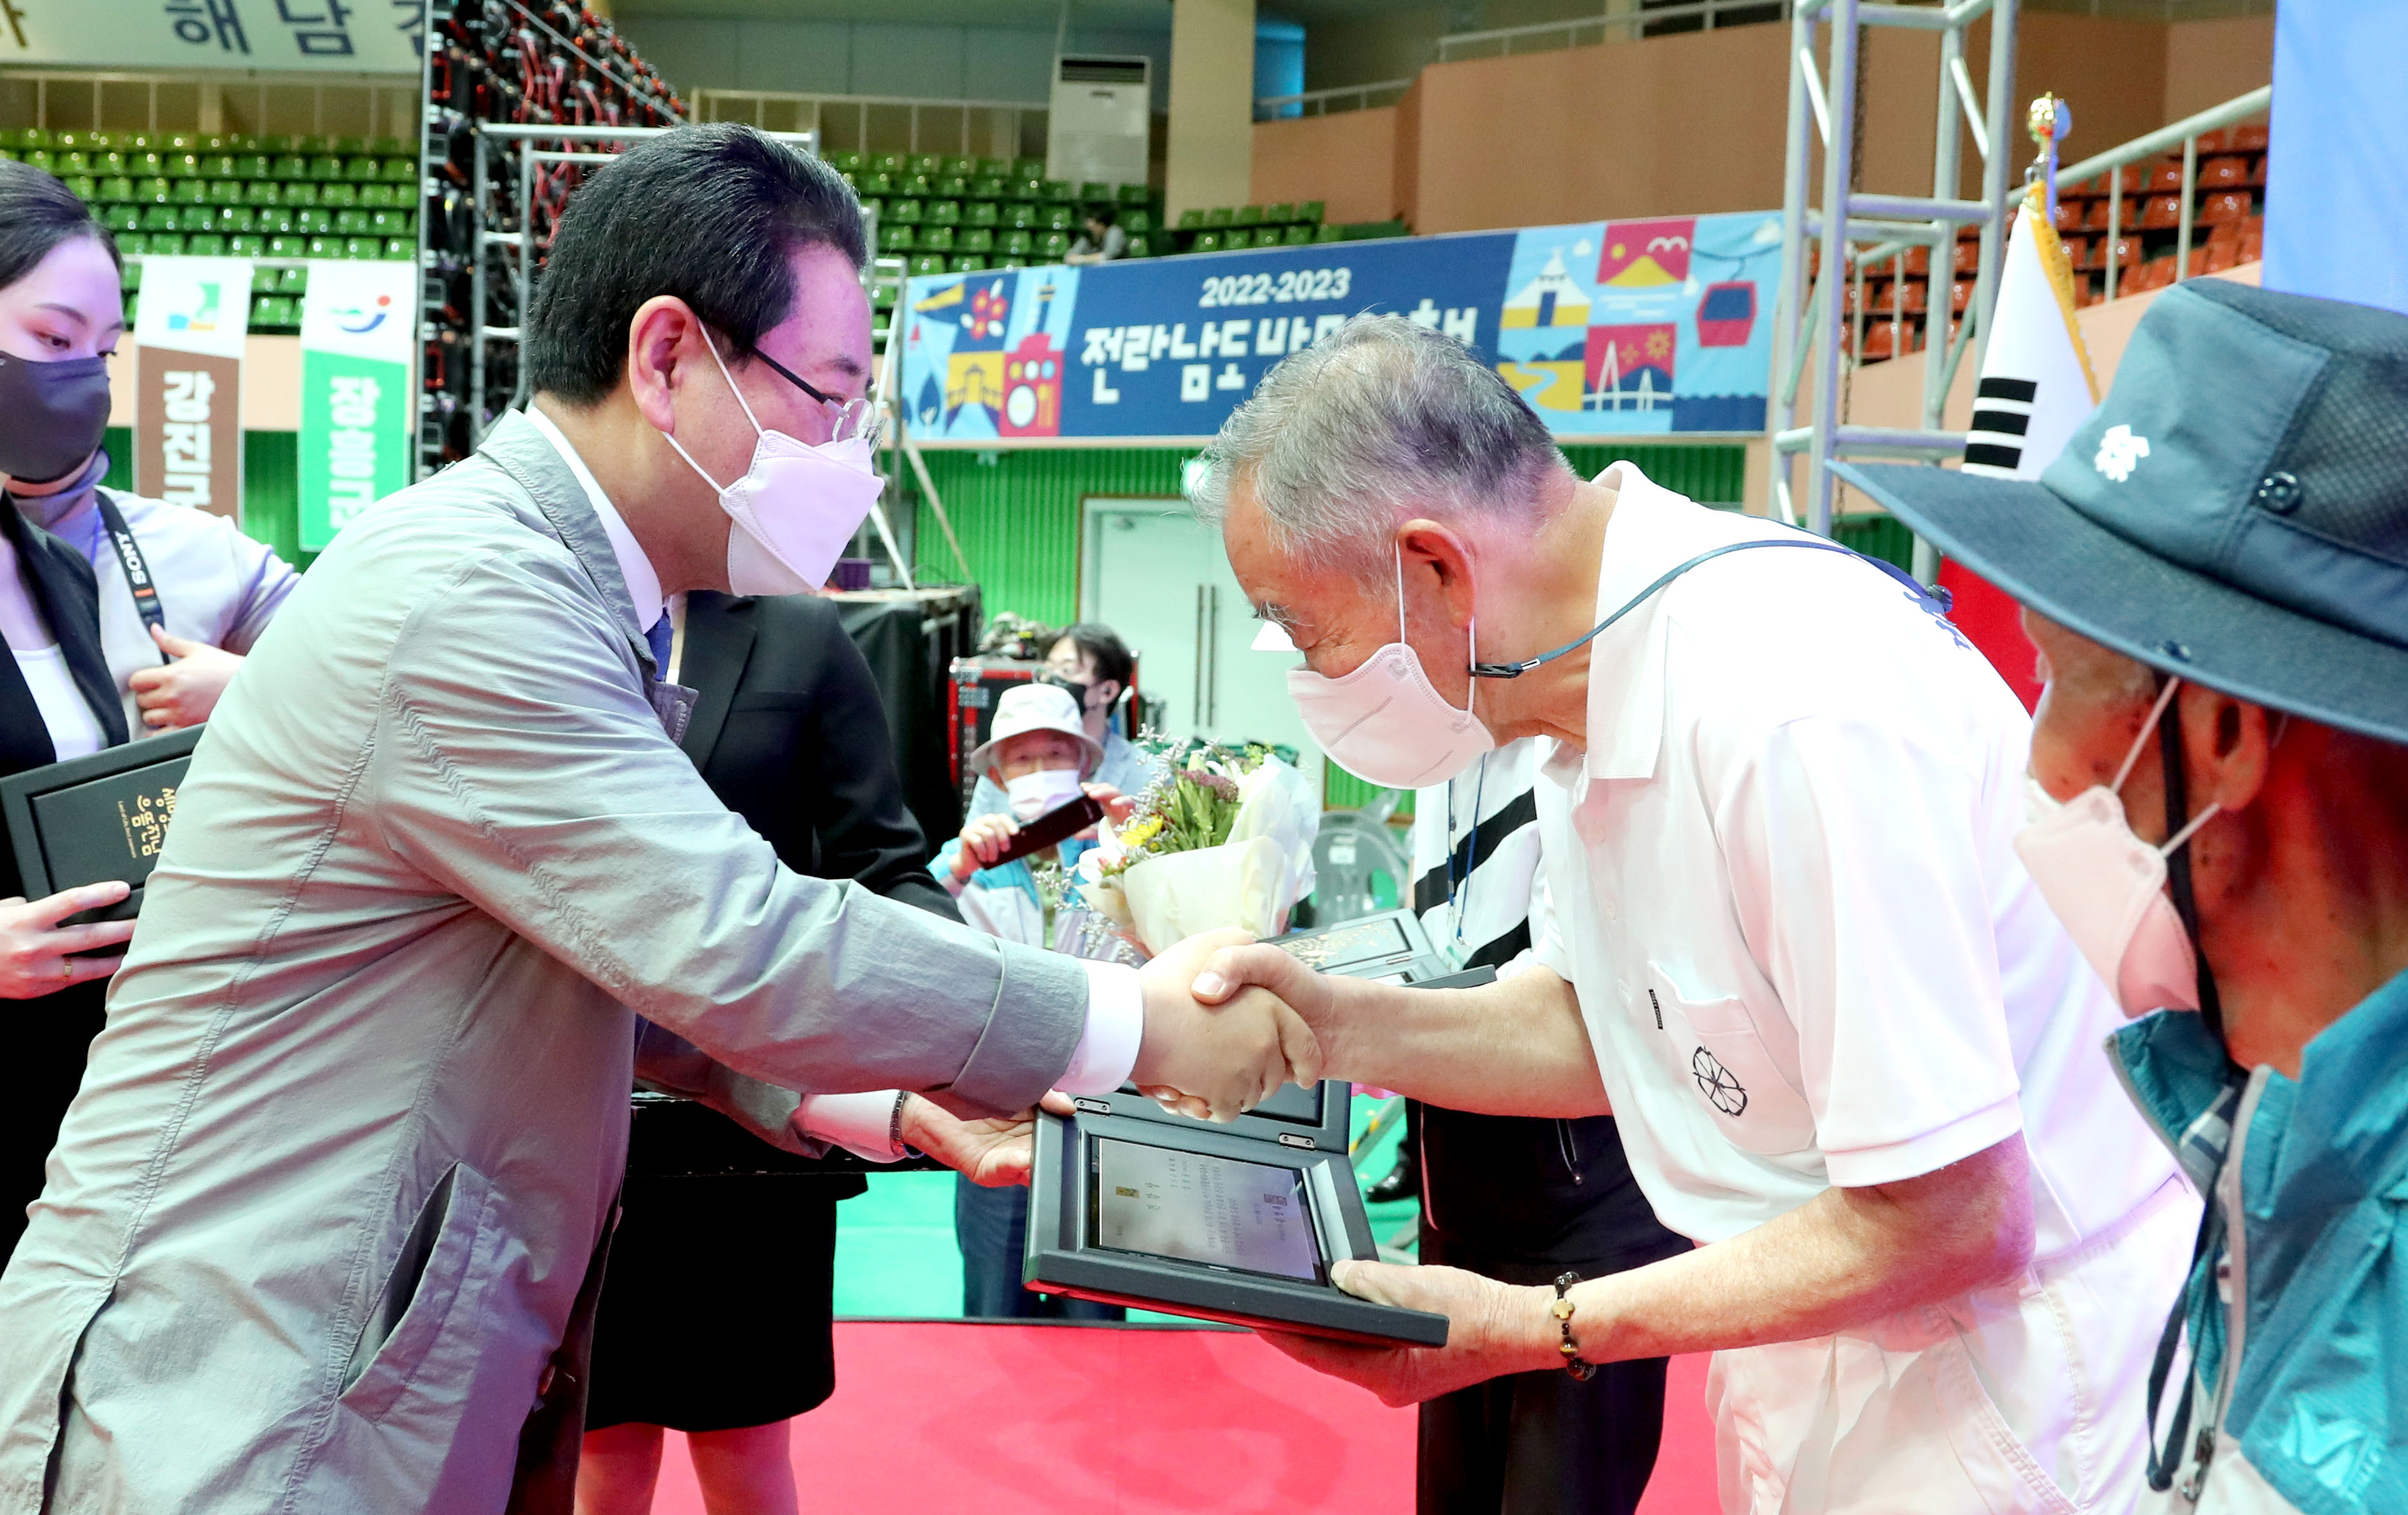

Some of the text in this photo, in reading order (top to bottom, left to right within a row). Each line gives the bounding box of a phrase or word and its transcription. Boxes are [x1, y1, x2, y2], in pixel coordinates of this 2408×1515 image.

[1198, 267, 1352, 308] 2022-2023
[1080, 319, 1252, 405] 전라남도
[115, 531, 148, 585] SONY
